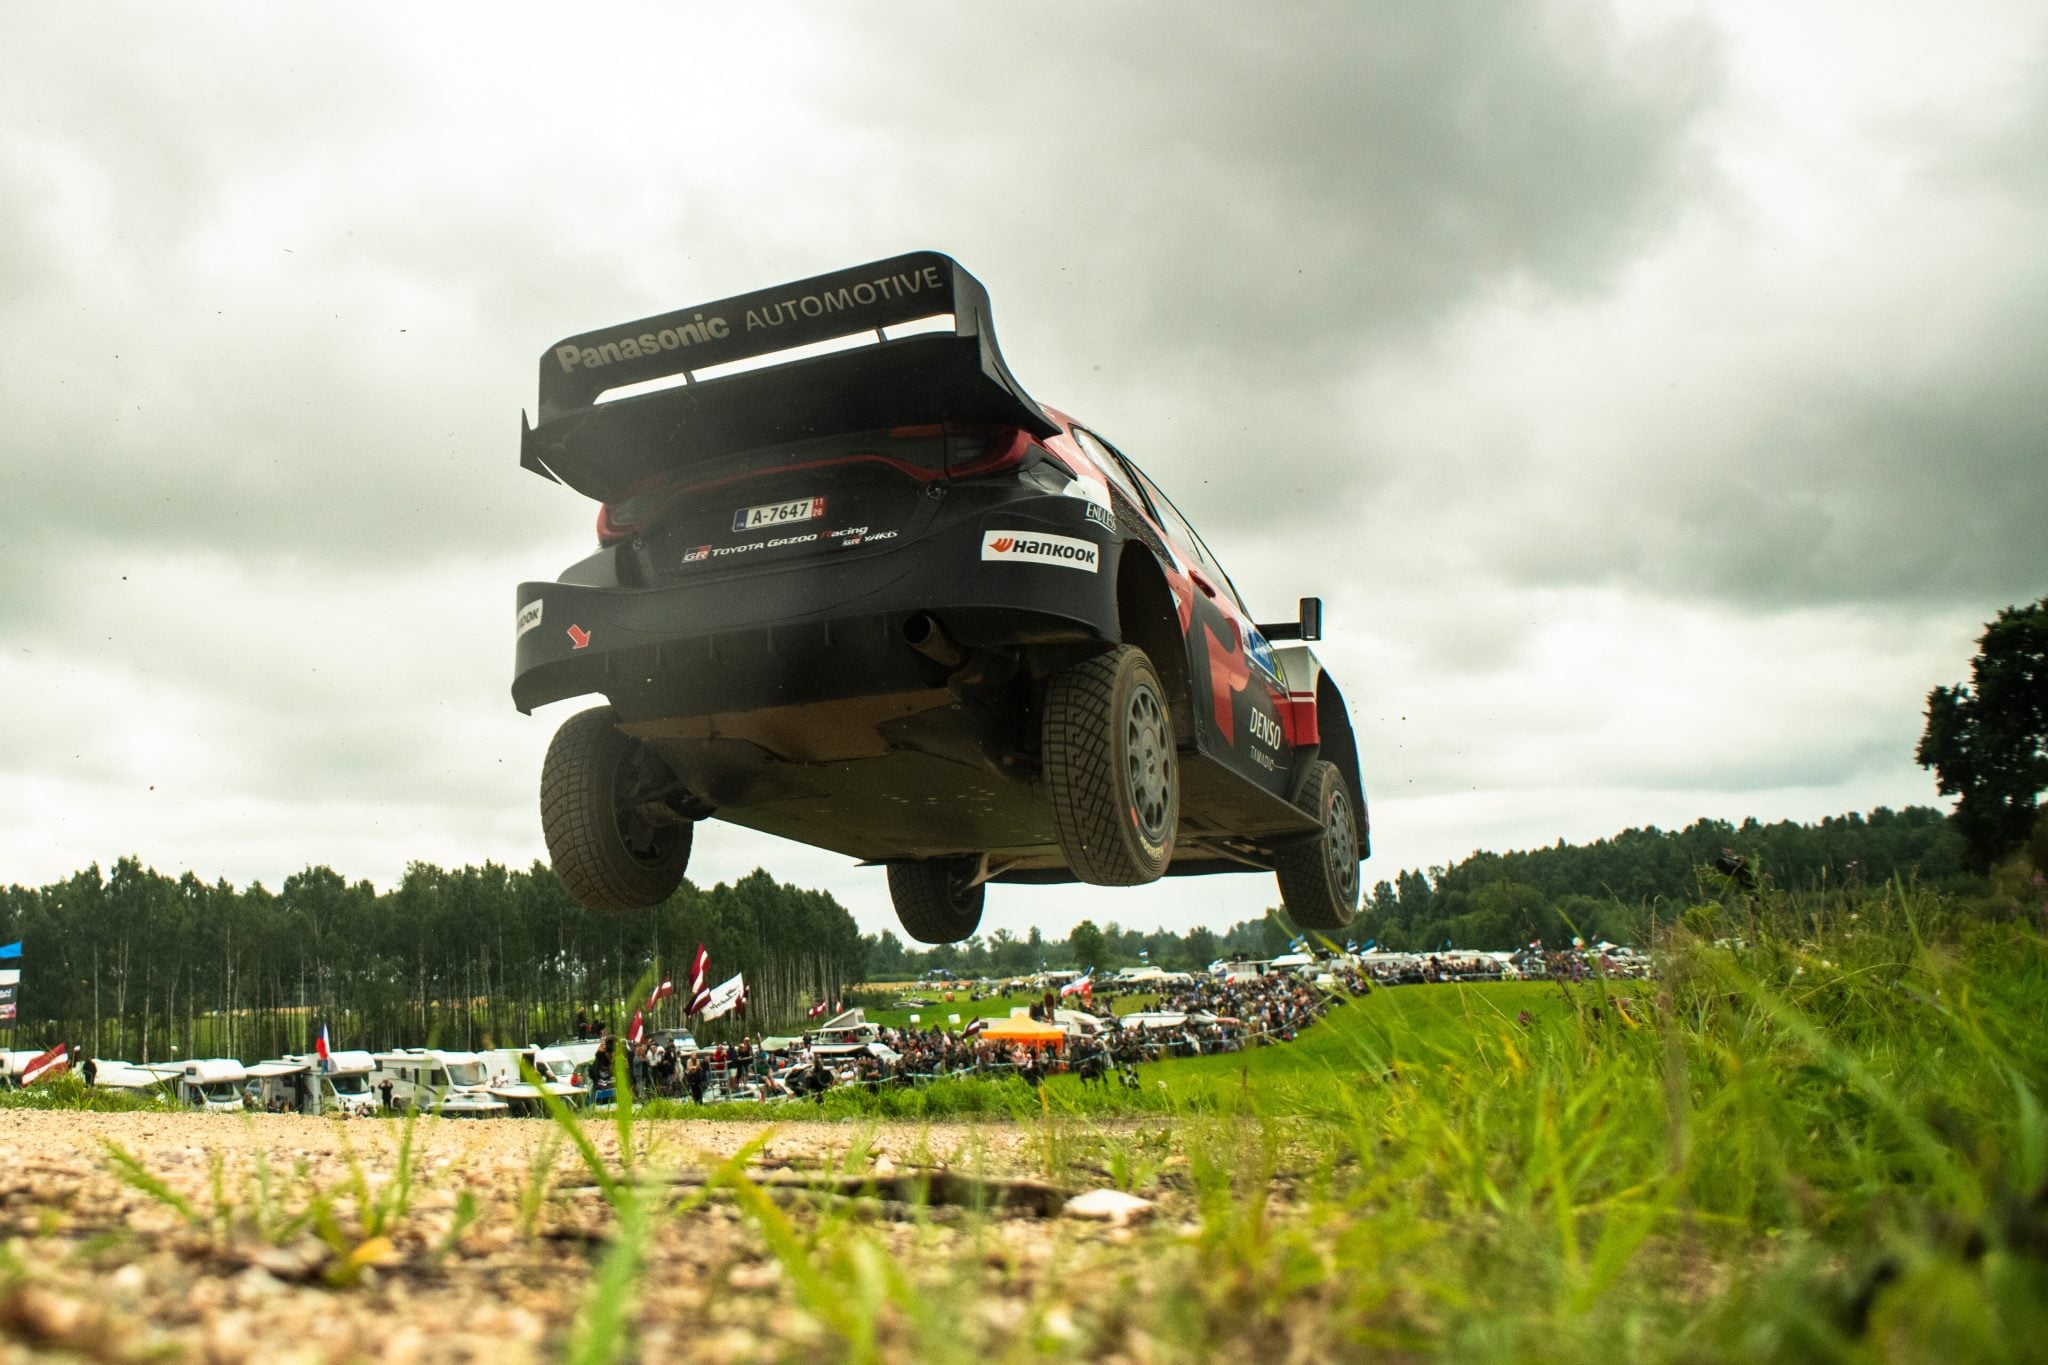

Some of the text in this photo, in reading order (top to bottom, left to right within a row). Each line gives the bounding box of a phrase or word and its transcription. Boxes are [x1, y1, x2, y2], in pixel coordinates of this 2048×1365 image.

[555, 266, 943, 374] Panasonic AUTOMOTIVE
[752, 502, 809, 525] A-7647
[815, 498, 823, 506] 11
[1086, 502, 1117, 531] ENDLESS
[683, 526, 869, 561] GR TOYOTA GAZOO Racing
[842, 537, 861, 546] GR
[1250, 706, 1281, 750] DENSO
